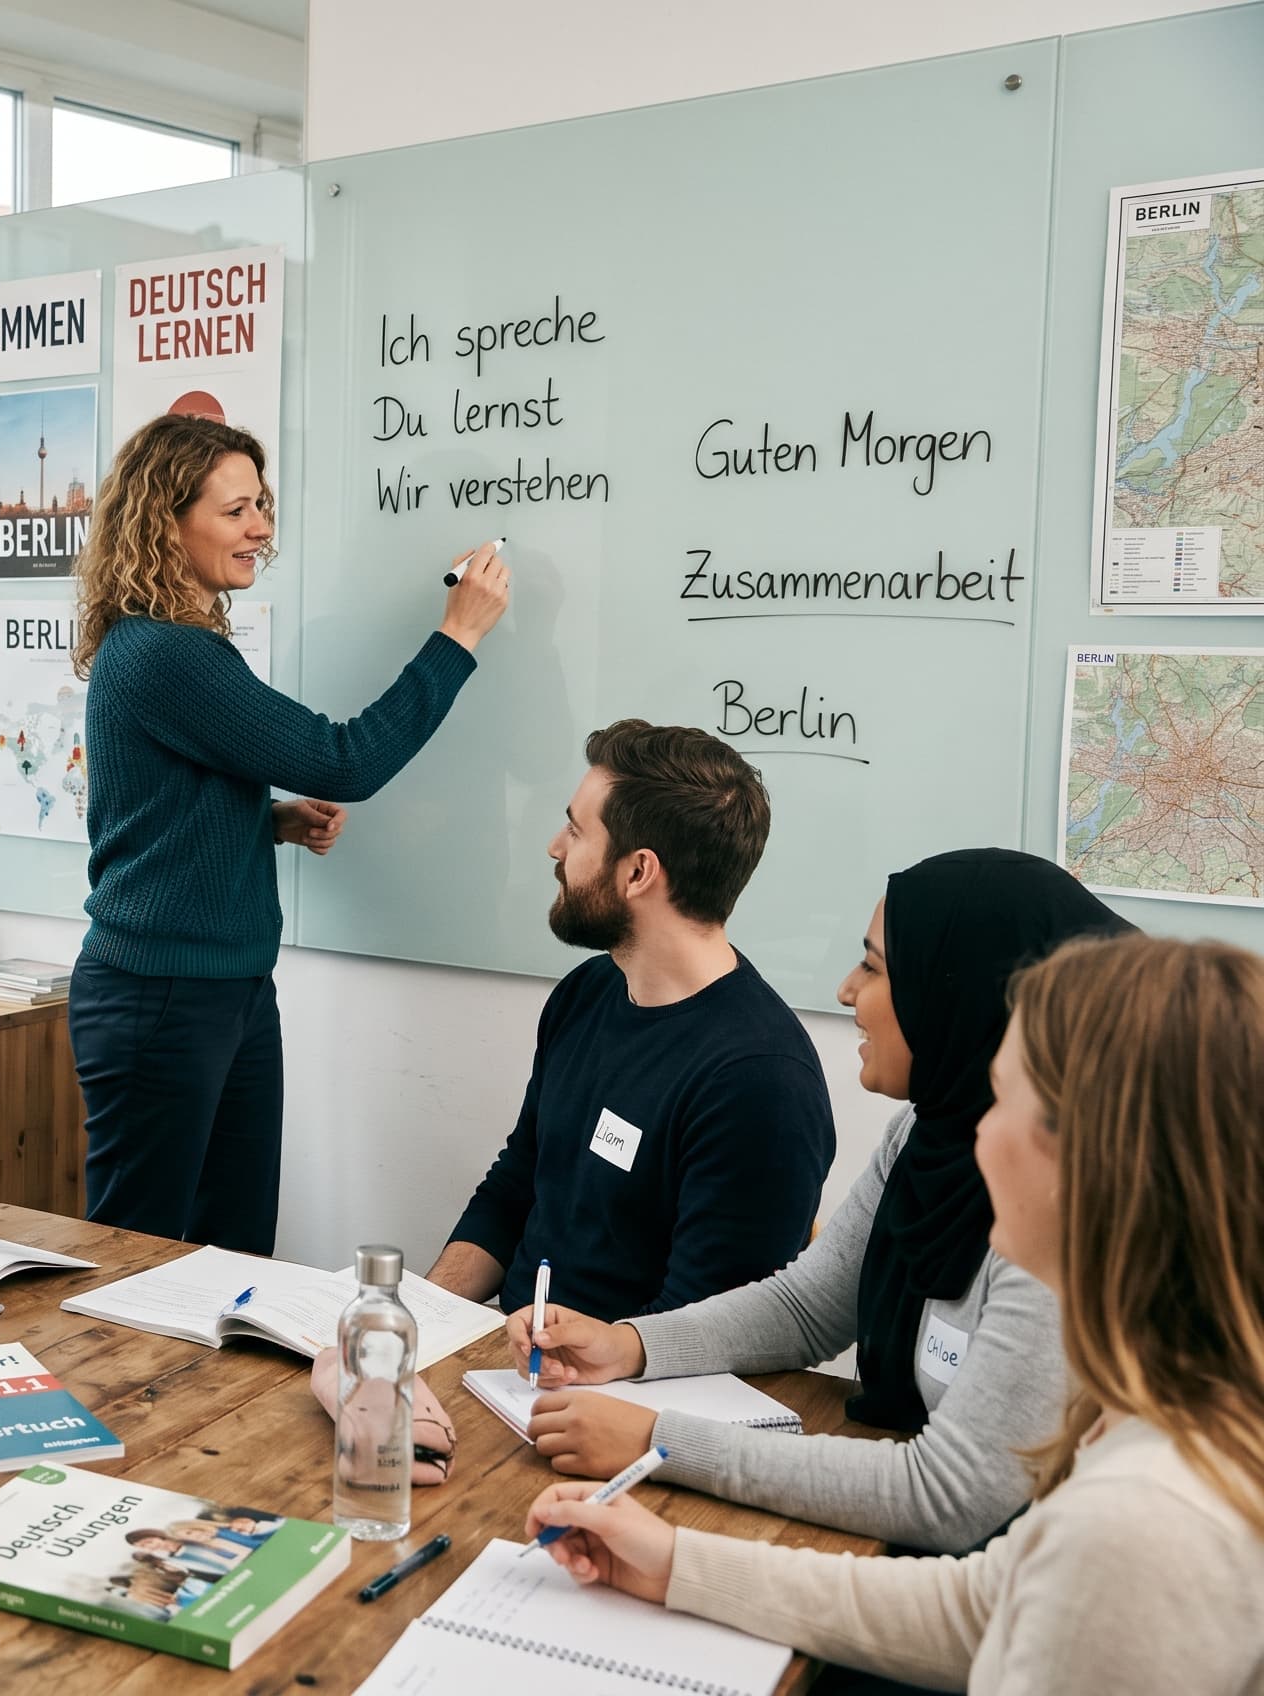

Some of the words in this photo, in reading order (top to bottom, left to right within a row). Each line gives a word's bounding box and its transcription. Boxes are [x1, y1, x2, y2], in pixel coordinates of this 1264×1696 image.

[1136, 201, 1201, 221] BERLIN
[129, 262, 266, 318] DEUTSCH
[138, 313, 255, 363] LERNEN
[381, 313, 430, 367] Ich
[455, 295, 606, 377] spreche
[373, 396, 428, 441] Du
[453, 377, 564, 434] lernst
[695, 418, 817, 479] Guten
[840, 410, 992, 496] Morgen
[377, 465, 429, 514] Wir
[449, 457, 609, 509] verstehen
[0, 515, 91, 557] BERLIN
[680, 548, 1025, 602] Zusammenarbeit
[6, 619, 74, 650] BERLI
[1077, 653, 1115, 664] BERLIN
[713, 680, 857, 744] Berlin
[36, 1495, 143, 1557] Übungen
